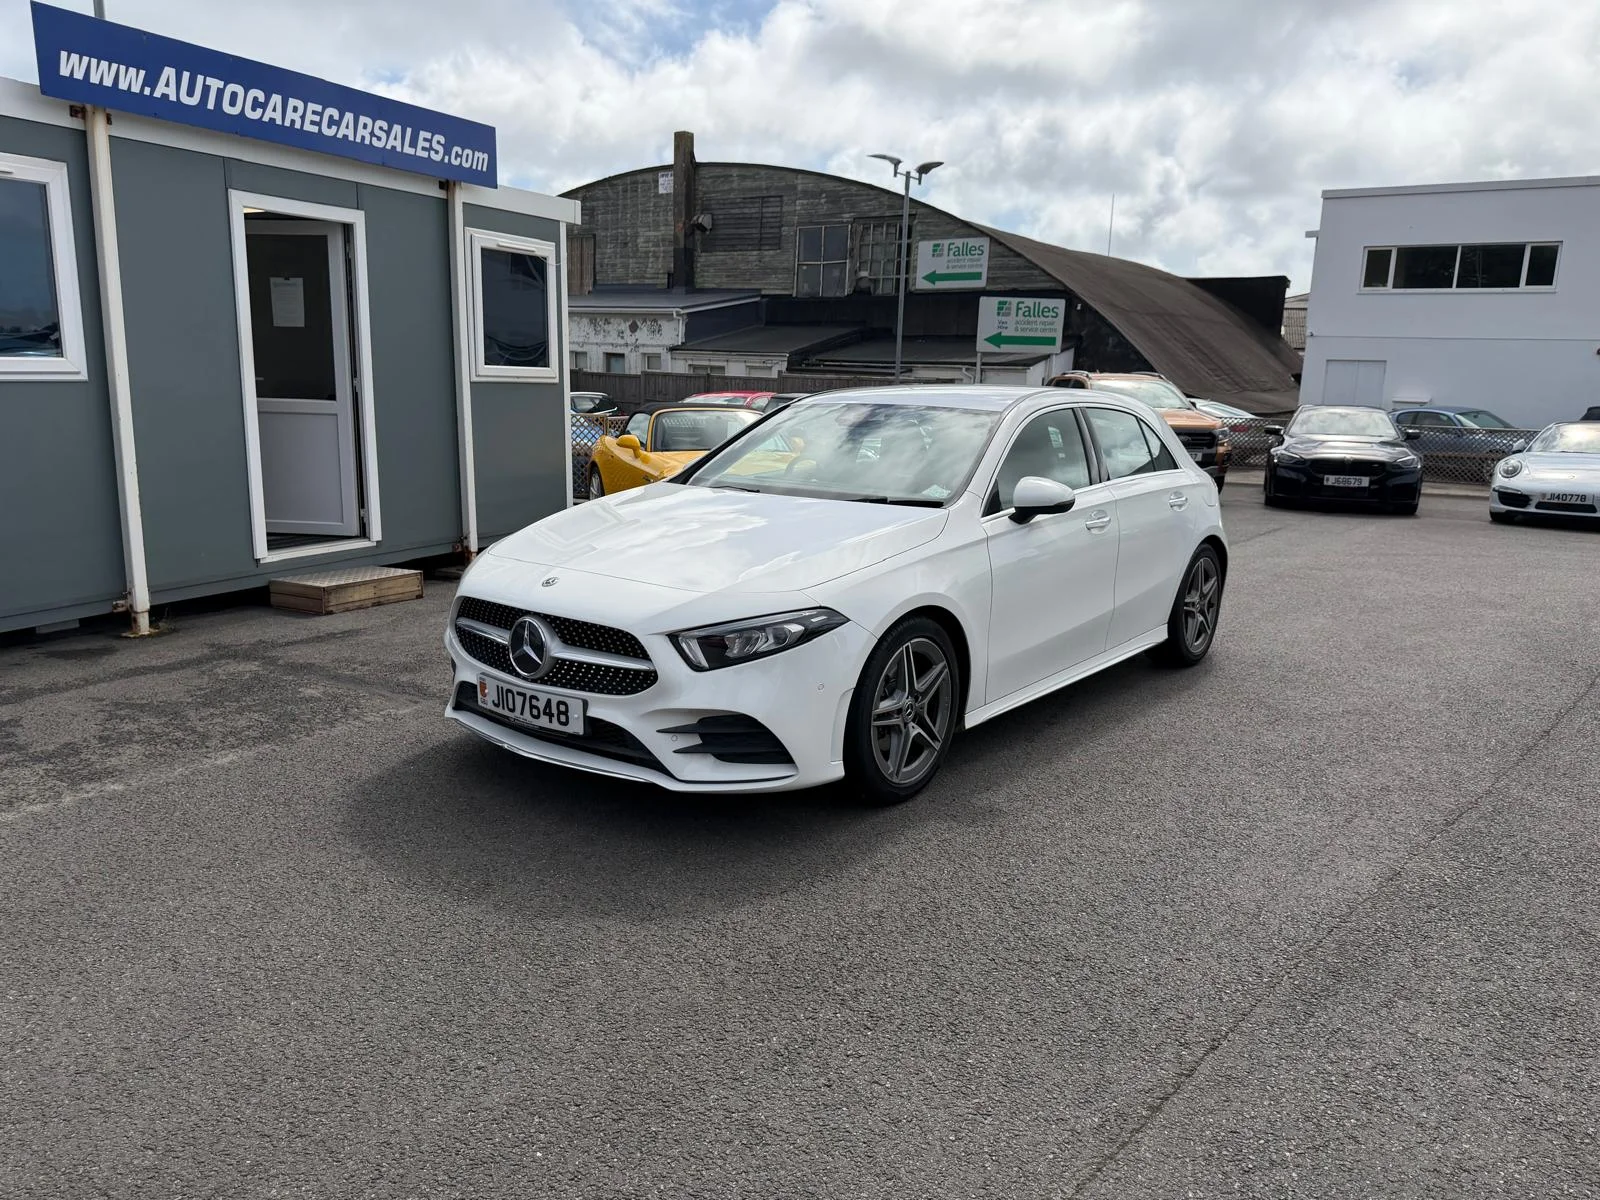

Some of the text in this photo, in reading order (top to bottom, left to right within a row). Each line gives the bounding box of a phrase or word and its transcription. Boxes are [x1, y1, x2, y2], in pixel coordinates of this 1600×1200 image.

[58, 49, 489, 173] www.AUTOCARECARSALES.com
[947, 241, 985, 257] Falles
[1015, 301, 1059, 318] Falles
[1547, 492, 1587, 503] J140778
[492, 684, 570, 727] J107648
